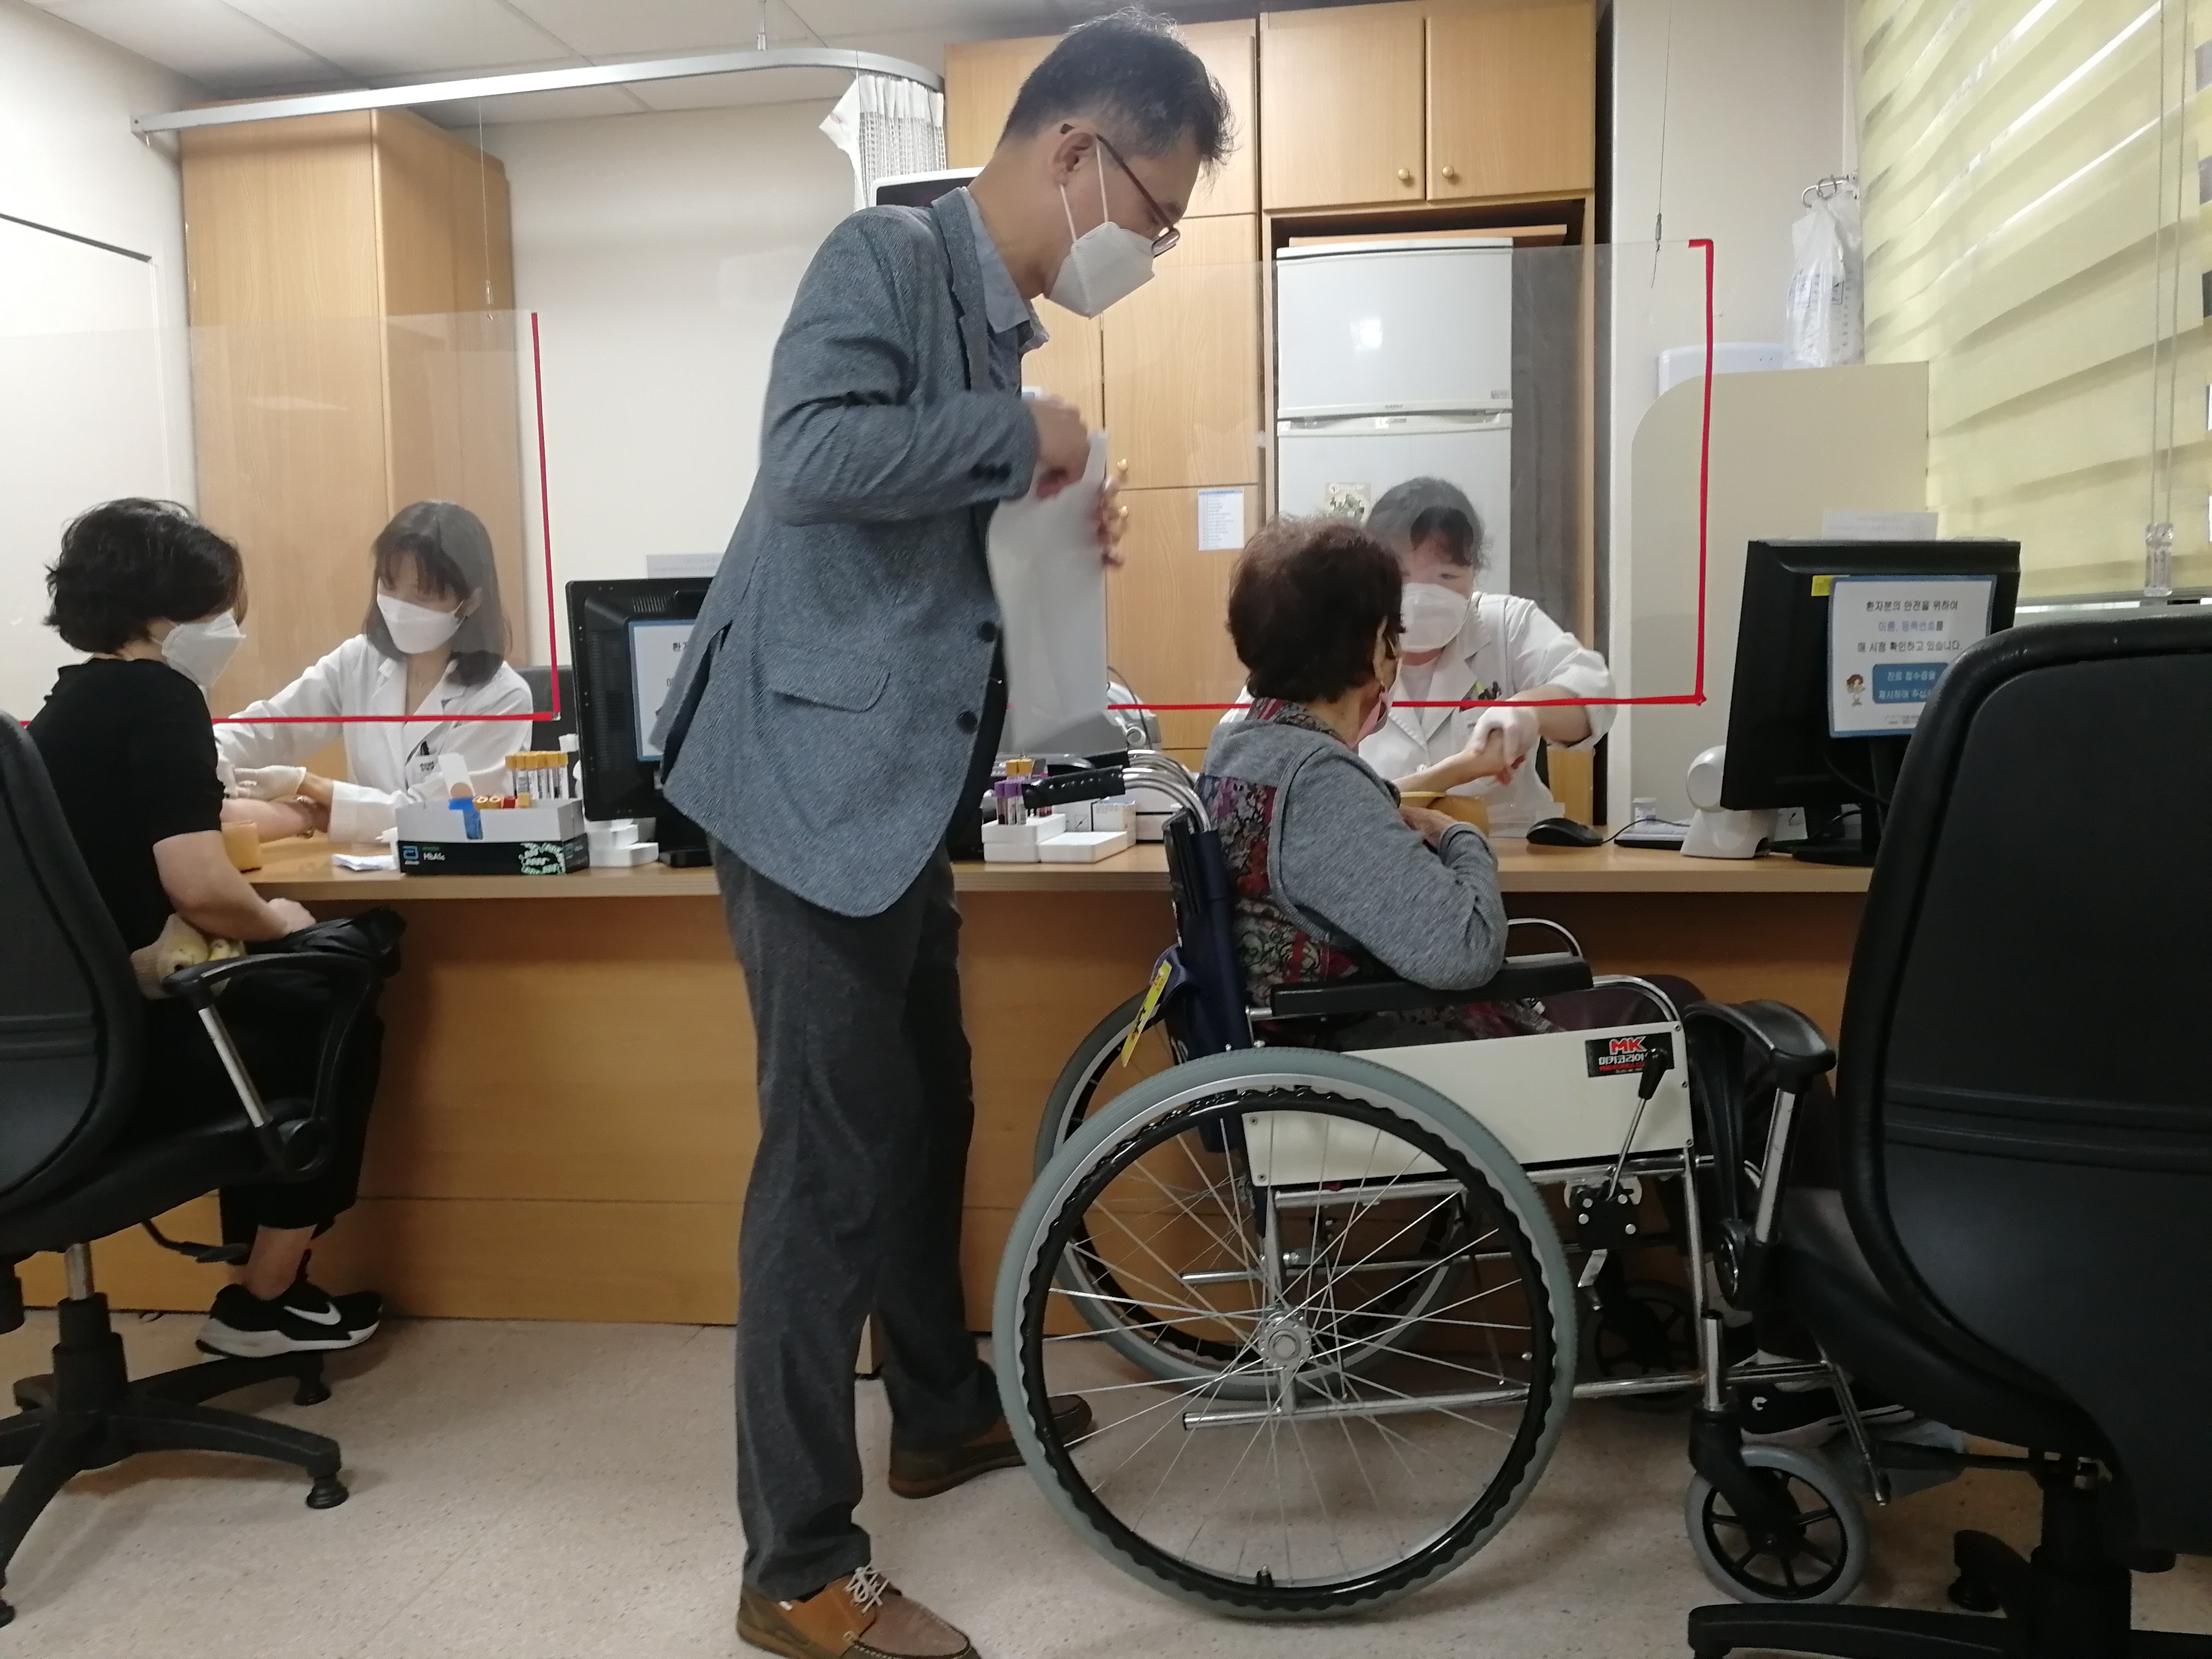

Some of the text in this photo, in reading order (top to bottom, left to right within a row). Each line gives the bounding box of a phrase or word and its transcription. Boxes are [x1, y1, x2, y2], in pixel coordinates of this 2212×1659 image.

[1866, 600, 1958, 612] 환자분의 안전을 위하여
[1890, 641, 1923, 652] 확인하고
[1927, 641, 1963, 652] 있습니다.
[1609, 1036, 1647, 1055] MK
